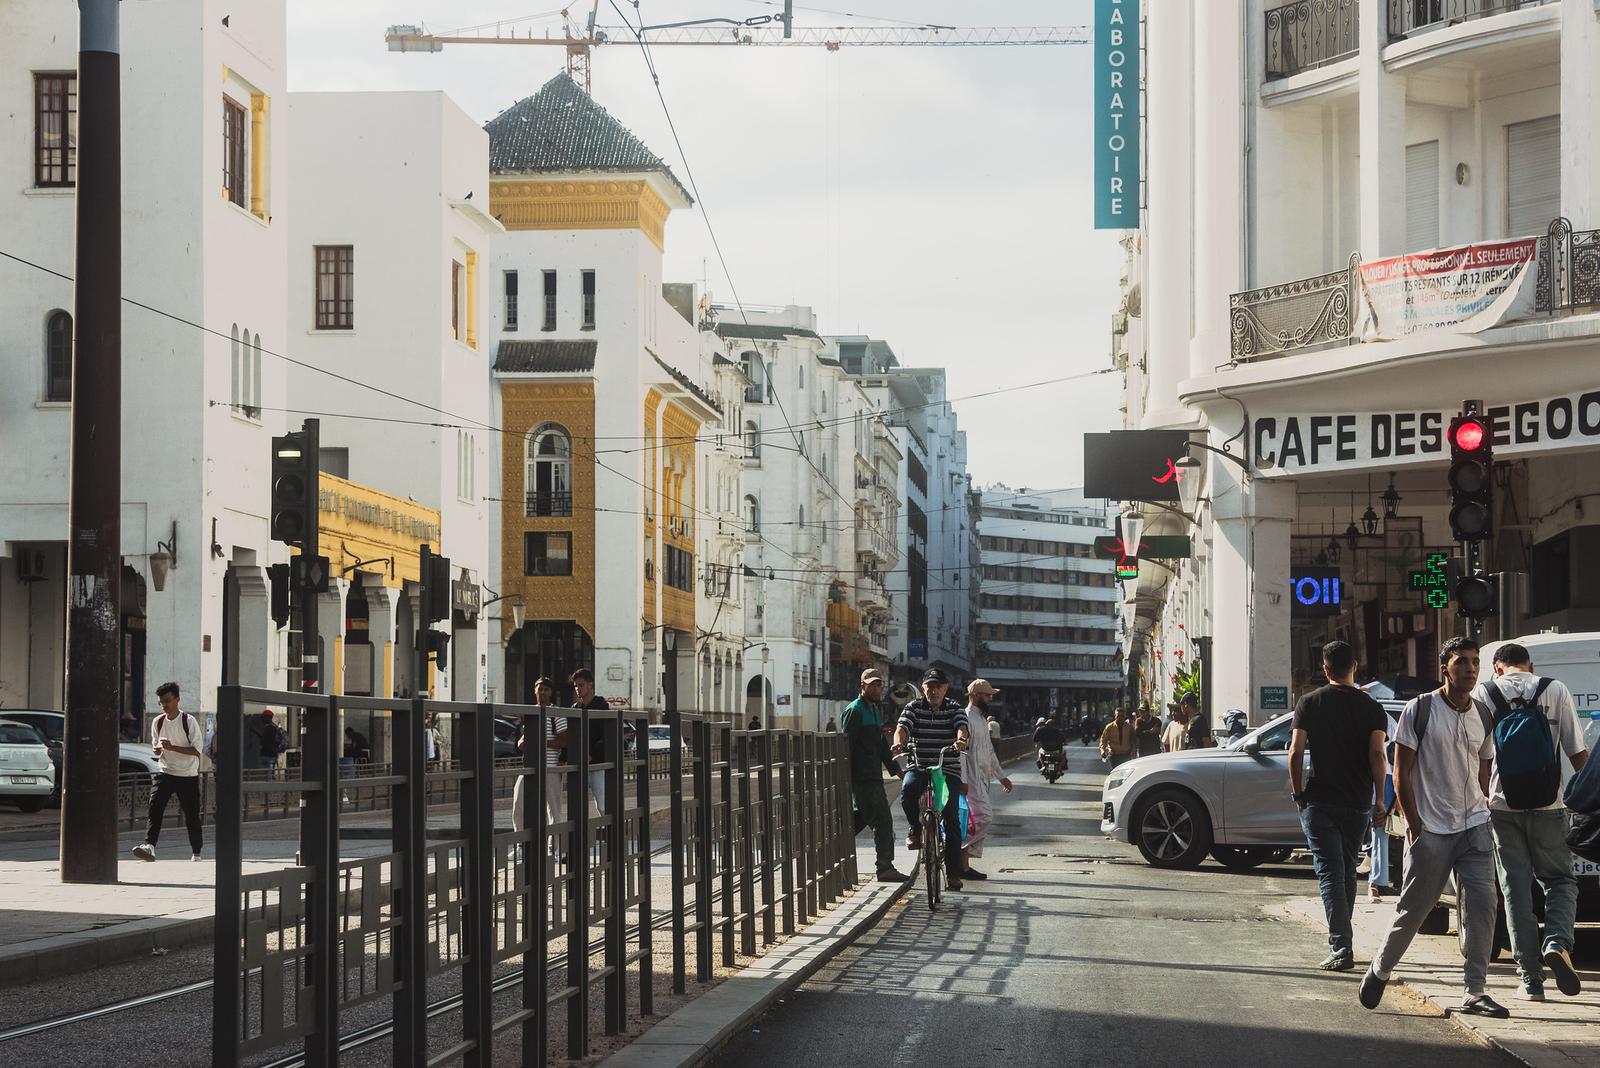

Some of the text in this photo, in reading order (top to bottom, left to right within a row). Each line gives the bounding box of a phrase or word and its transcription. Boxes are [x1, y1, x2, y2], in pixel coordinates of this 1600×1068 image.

[1109, 0, 1125, 215] ABORATOIRE
[1477, 244, 1533, 263] SEULEMENT
[1452, 273, 1468, 287] SUR
[1471, 272, 1480, 284] 12
[1406, 296, 1414, 304] et
[1255, 391, 1600, 469] CAFE DES EGOC
[1582, 862, 1593, 874] je
